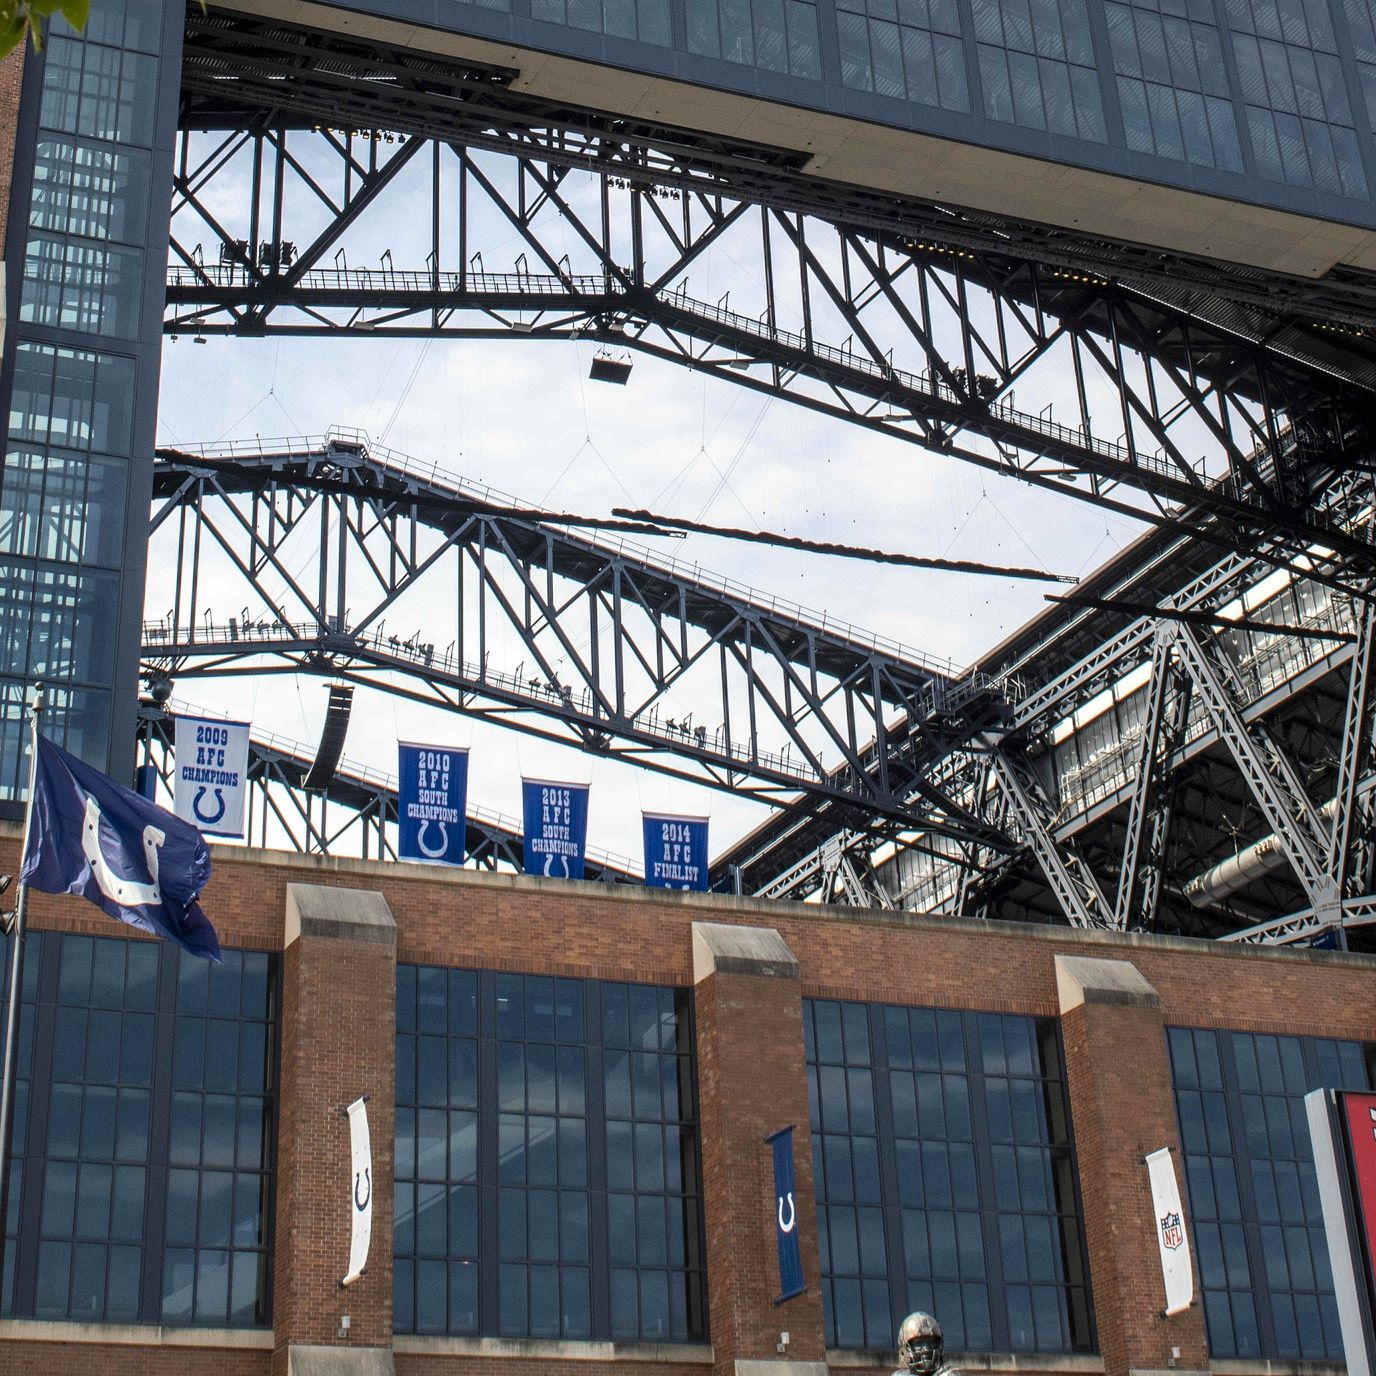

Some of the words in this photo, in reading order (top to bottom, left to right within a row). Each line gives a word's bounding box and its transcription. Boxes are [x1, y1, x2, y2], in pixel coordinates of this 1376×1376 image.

[196, 725, 229, 746] 2009
[196, 746, 225, 767] AFC
[418, 751, 450, 772] 2010
[182, 766, 239, 787] CHAMPIONS
[418, 769, 449, 790] AFC
[418, 789, 448, 806] SOUTH
[542, 788, 570, 807] 2013
[407, 803, 458, 823] CHAMPIONS
[543, 806, 570, 825] AFC
[542, 825, 570, 841] SOUTH
[662, 823, 691, 843] 2014
[531, 838, 578, 857] CHAMPIONS
[664, 843, 691, 863] AFC
[654, 862, 699, 882] FINALIST
[1164, 1226, 1183, 1246] NFL
